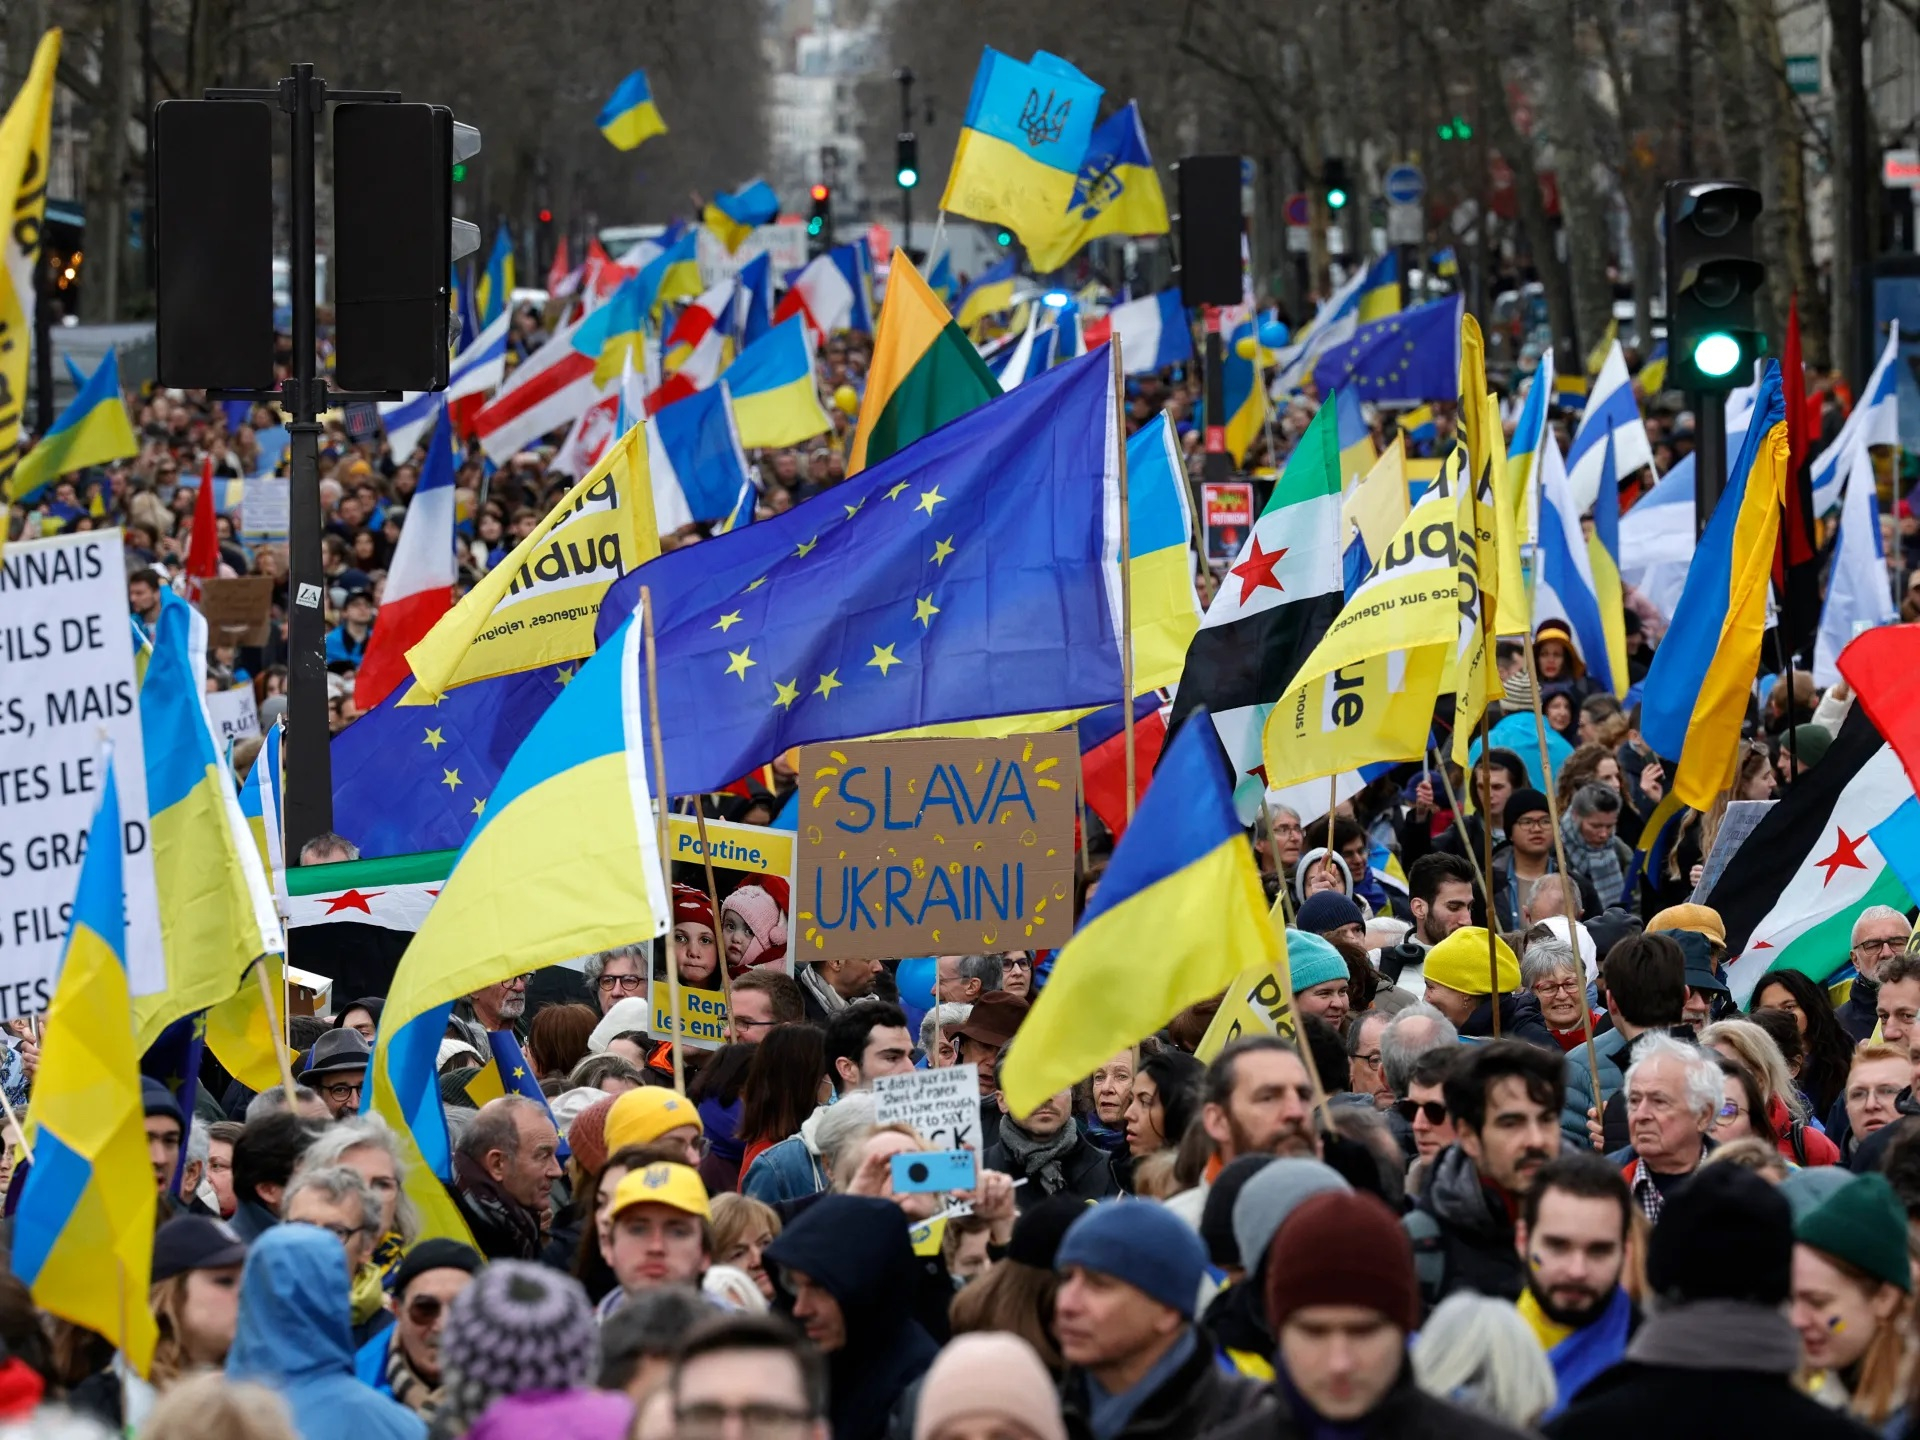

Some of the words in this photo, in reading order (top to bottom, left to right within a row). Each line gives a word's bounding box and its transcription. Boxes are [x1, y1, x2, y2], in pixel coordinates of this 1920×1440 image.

[0, 622, 52, 662] ILS
[61, 615, 104, 654] DE
[0, 698, 35, 738] S,
[46, 680, 133, 727] MAIS
[835, 757, 1037, 834] SLAVA
[26, 821, 147, 872] GRAD
[678, 834, 768, 869] Poutine,
[815, 862, 1024, 932] UKRAINI
